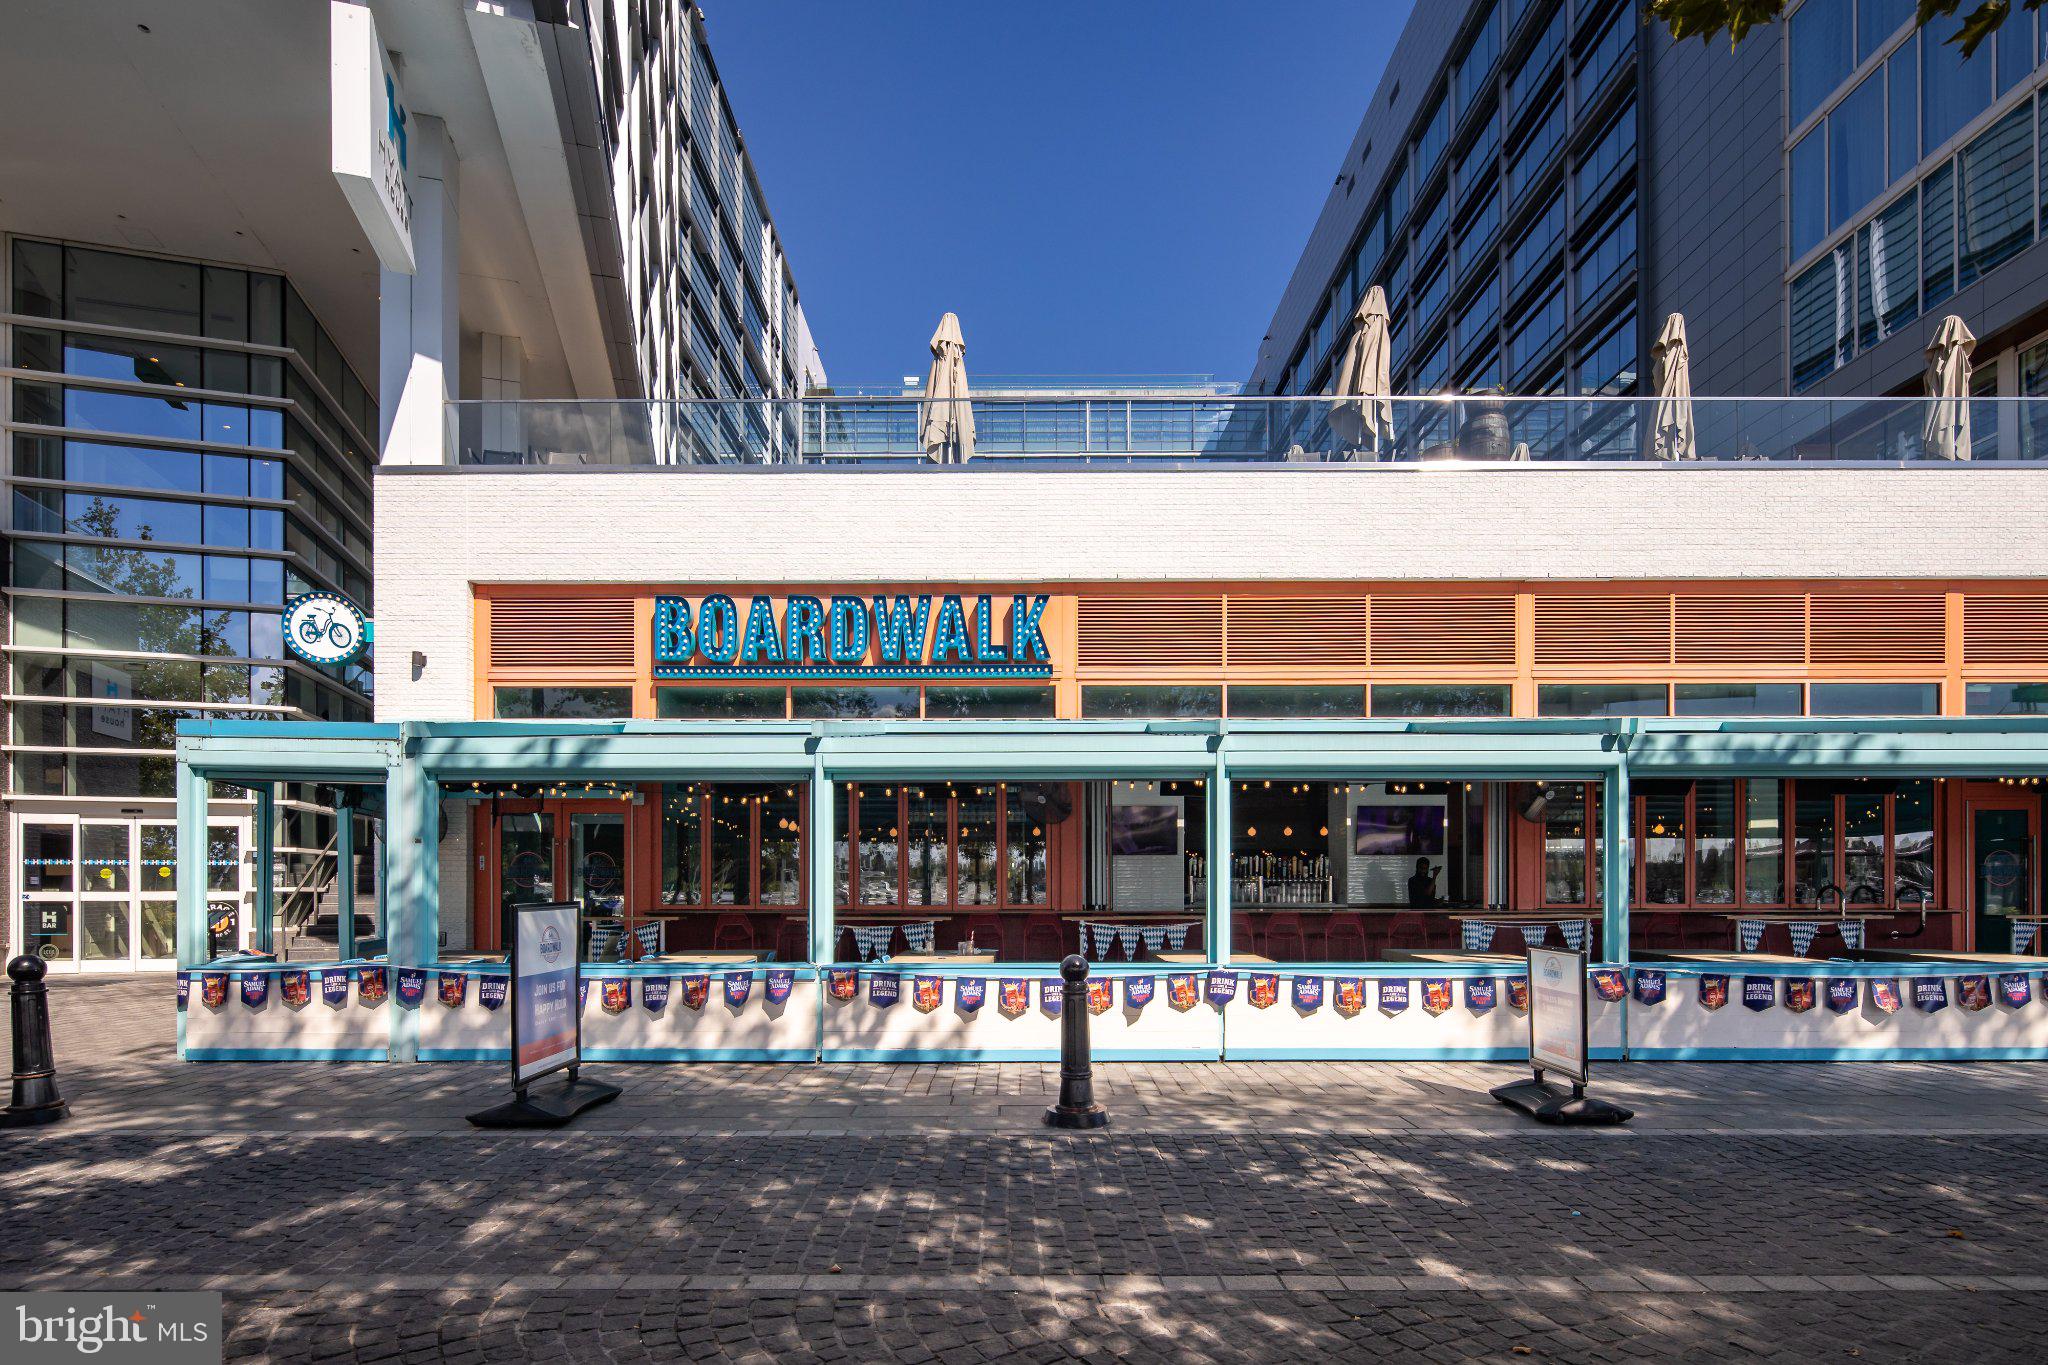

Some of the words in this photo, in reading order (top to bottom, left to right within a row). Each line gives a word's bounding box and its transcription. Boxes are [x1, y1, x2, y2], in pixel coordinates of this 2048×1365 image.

[378, 129, 414, 219] HYATT
[385, 168, 409, 232] house
[653, 593, 1051, 662] BOARDWALK
[534, 984, 547, 996] JOIN
[548, 982, 556, 994] US
[534, 1001, 554, 1017] HAPPY
